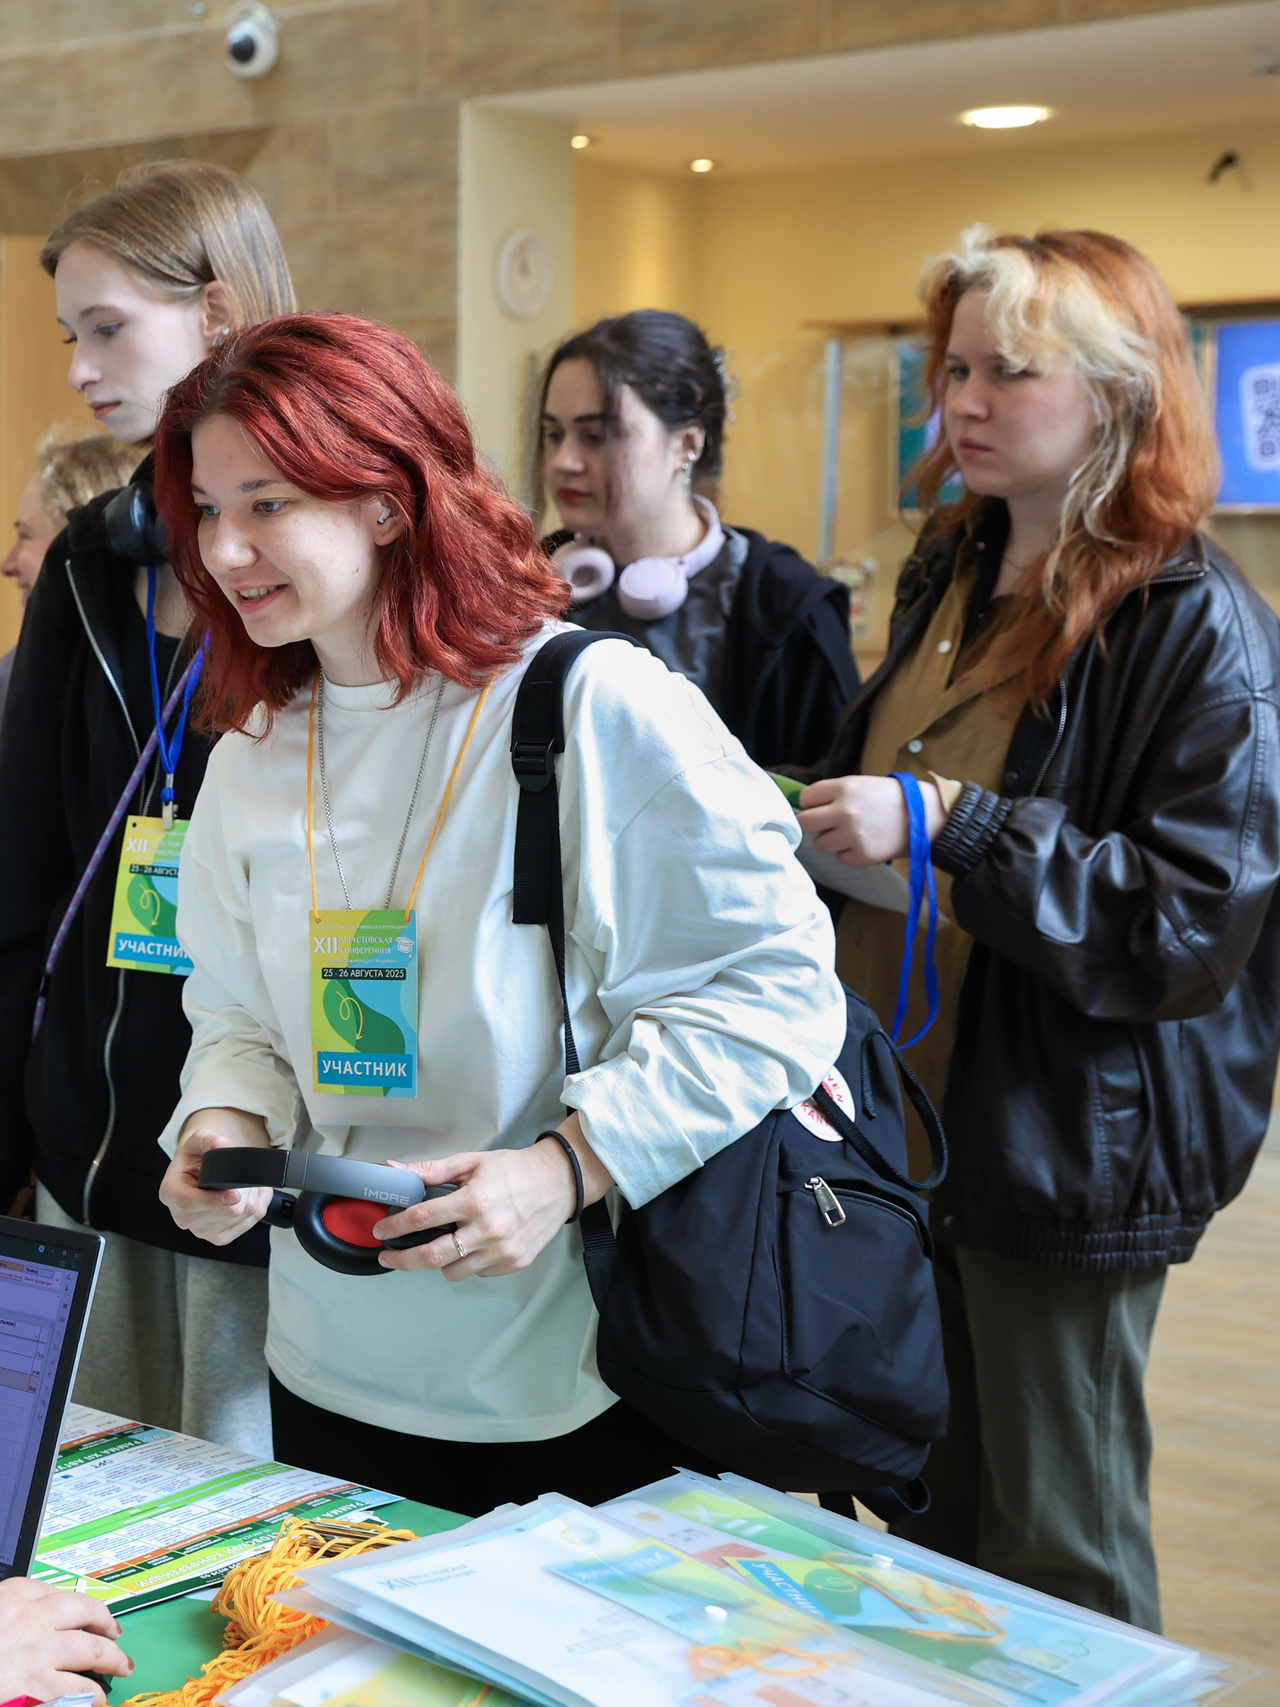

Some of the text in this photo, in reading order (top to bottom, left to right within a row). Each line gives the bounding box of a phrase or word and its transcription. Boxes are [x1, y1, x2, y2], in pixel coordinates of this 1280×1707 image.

[126, 837, 148, 853] XII
[153, 867, 179, 876] АВГУСТ
[313, 937, 338, 954] XII
[340, 936, 393, 944] АВГУСТОВСКАЯ
[340, 947, 392, 955] КОНФЕРЕНЦИЯ
[323, 968, 333, 977] 25
[339, 969, 349, 978] 26
[350, 969, 383, 978] АВГУСТА
[385, 969, 405, 978] 2025
[322, 1059, 407, 1077] УЧАСТНИК
[363, 1186, 410, 1206] 1MORE
[135, 1551, 224, 1587] КОНФЕРЕНЦИИ
